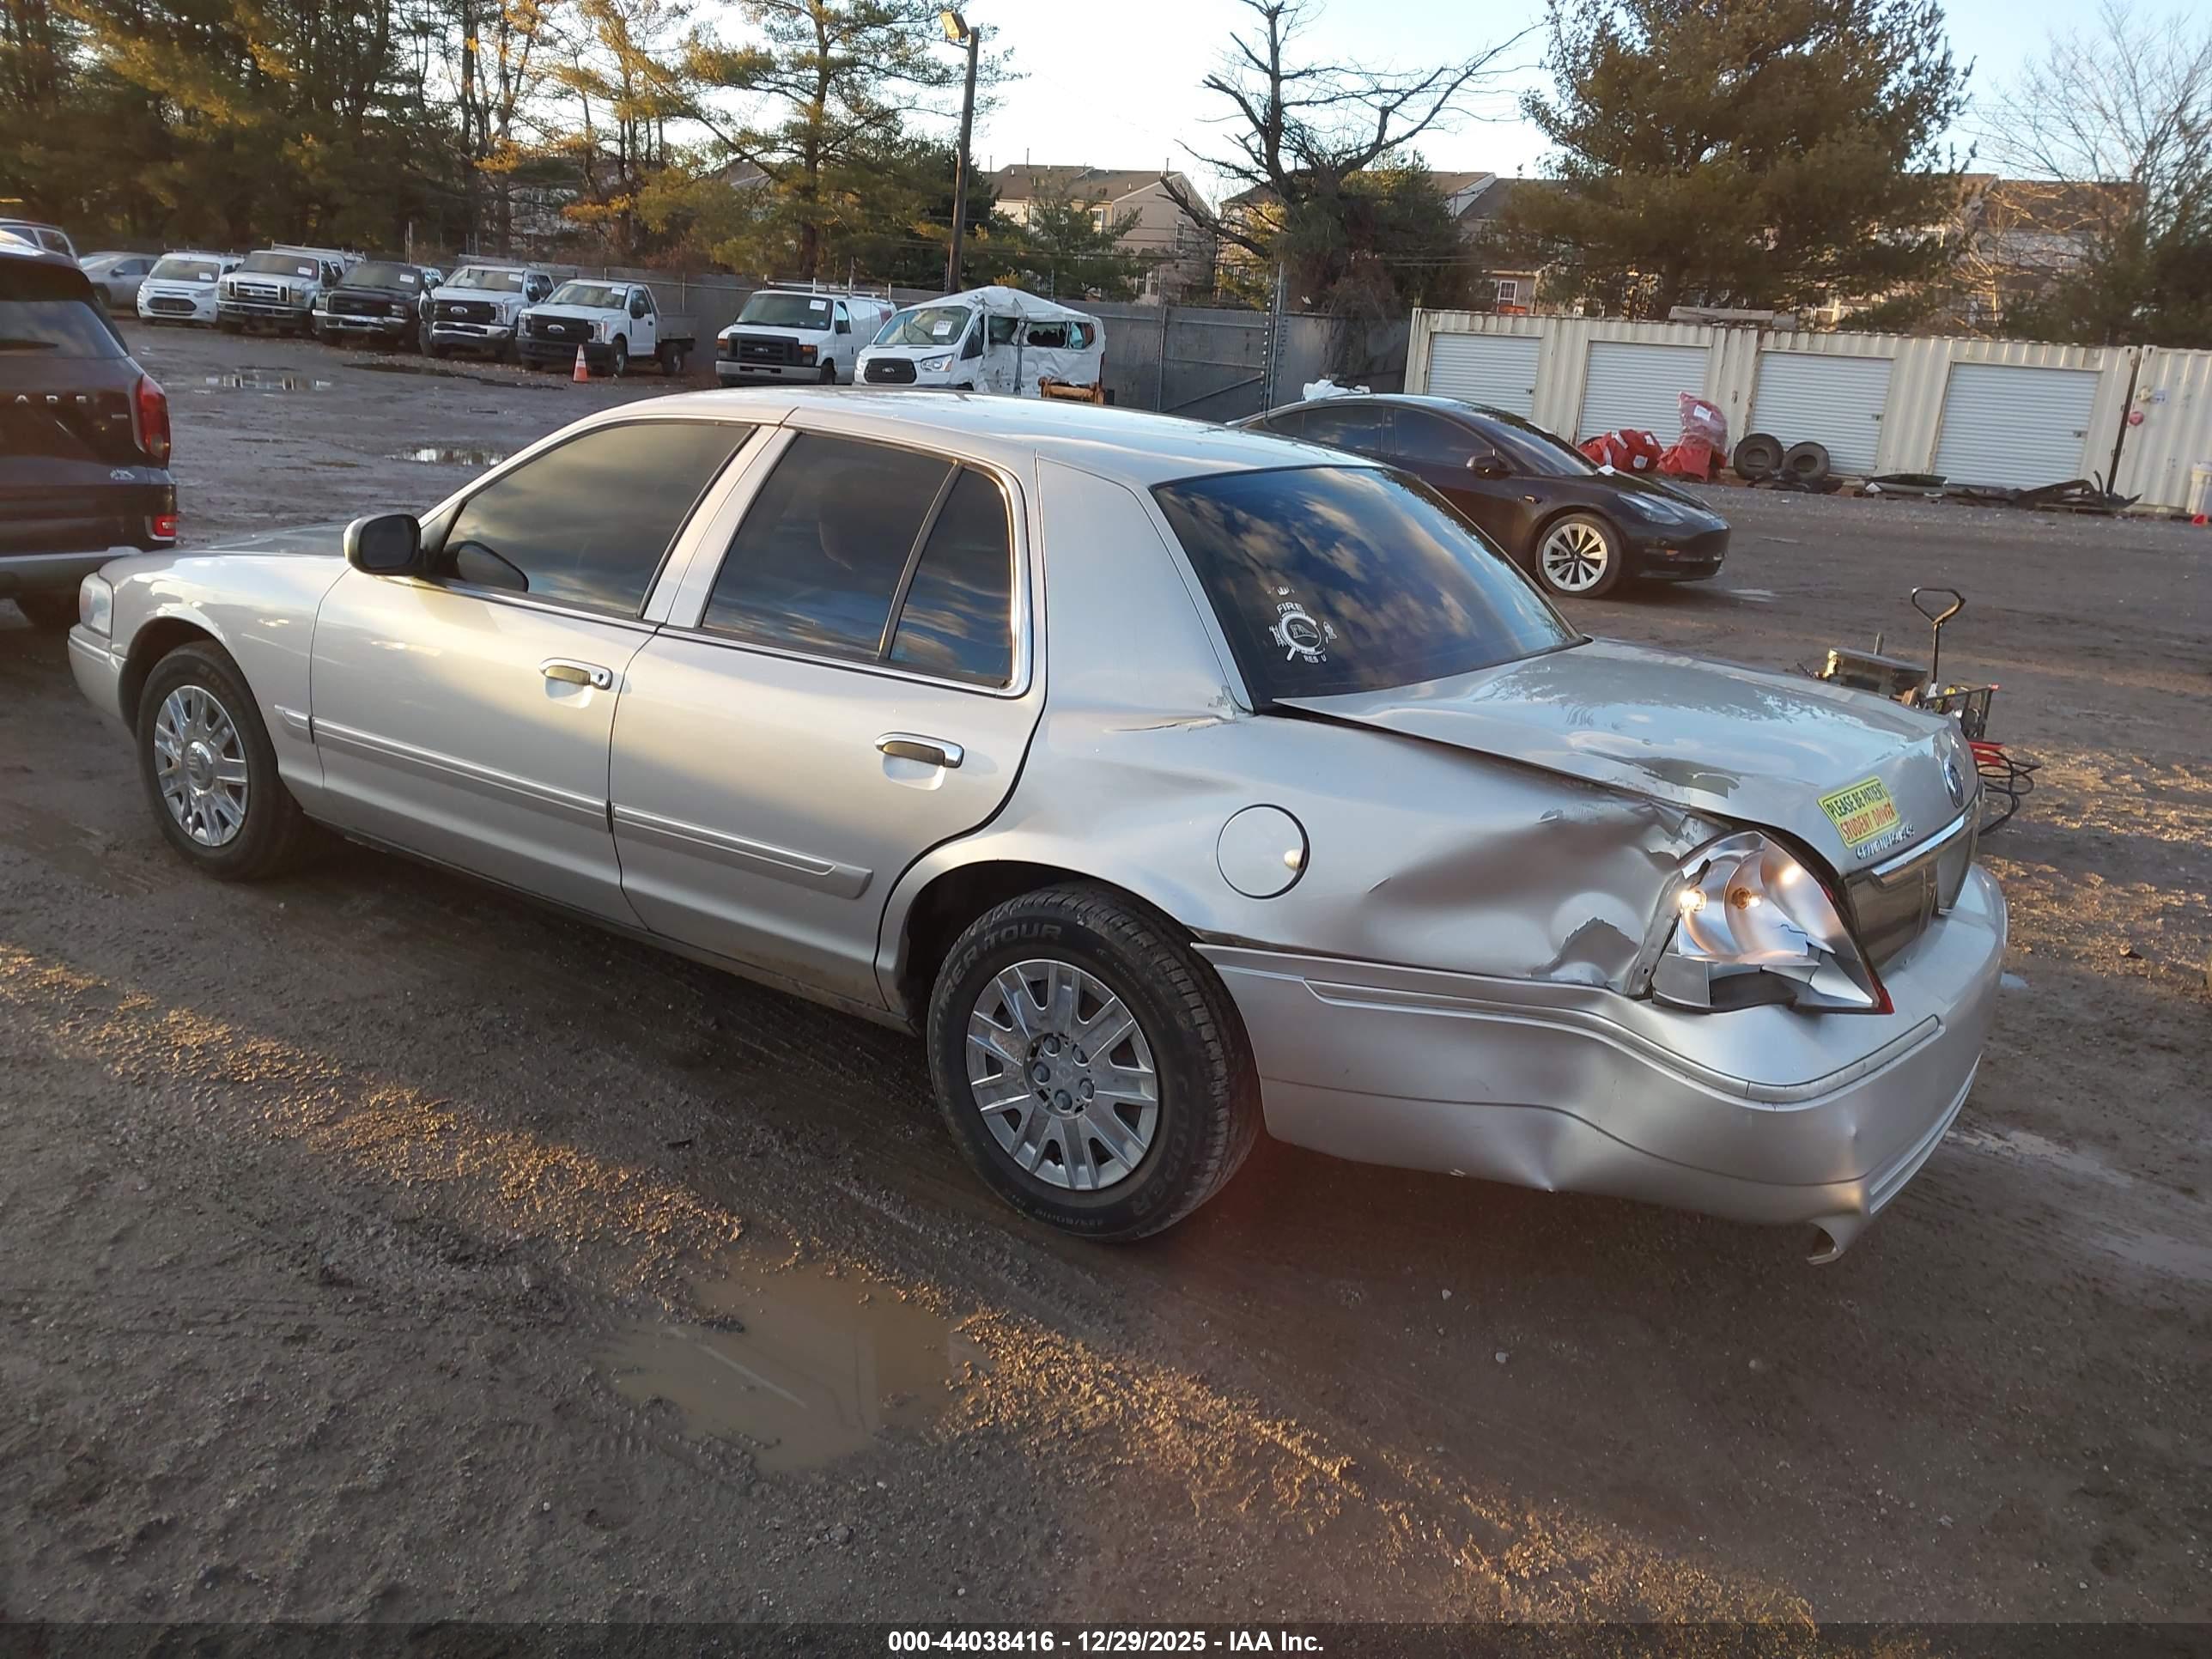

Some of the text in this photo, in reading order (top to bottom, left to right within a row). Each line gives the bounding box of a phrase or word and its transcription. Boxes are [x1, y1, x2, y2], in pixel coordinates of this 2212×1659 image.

[1277, 601, 1304, 614] FIRE
[1826, 782, 1887, 819] PLEASE BE PATIENT
[1840, 802, 1897, 841] STUDENT DRIVER
